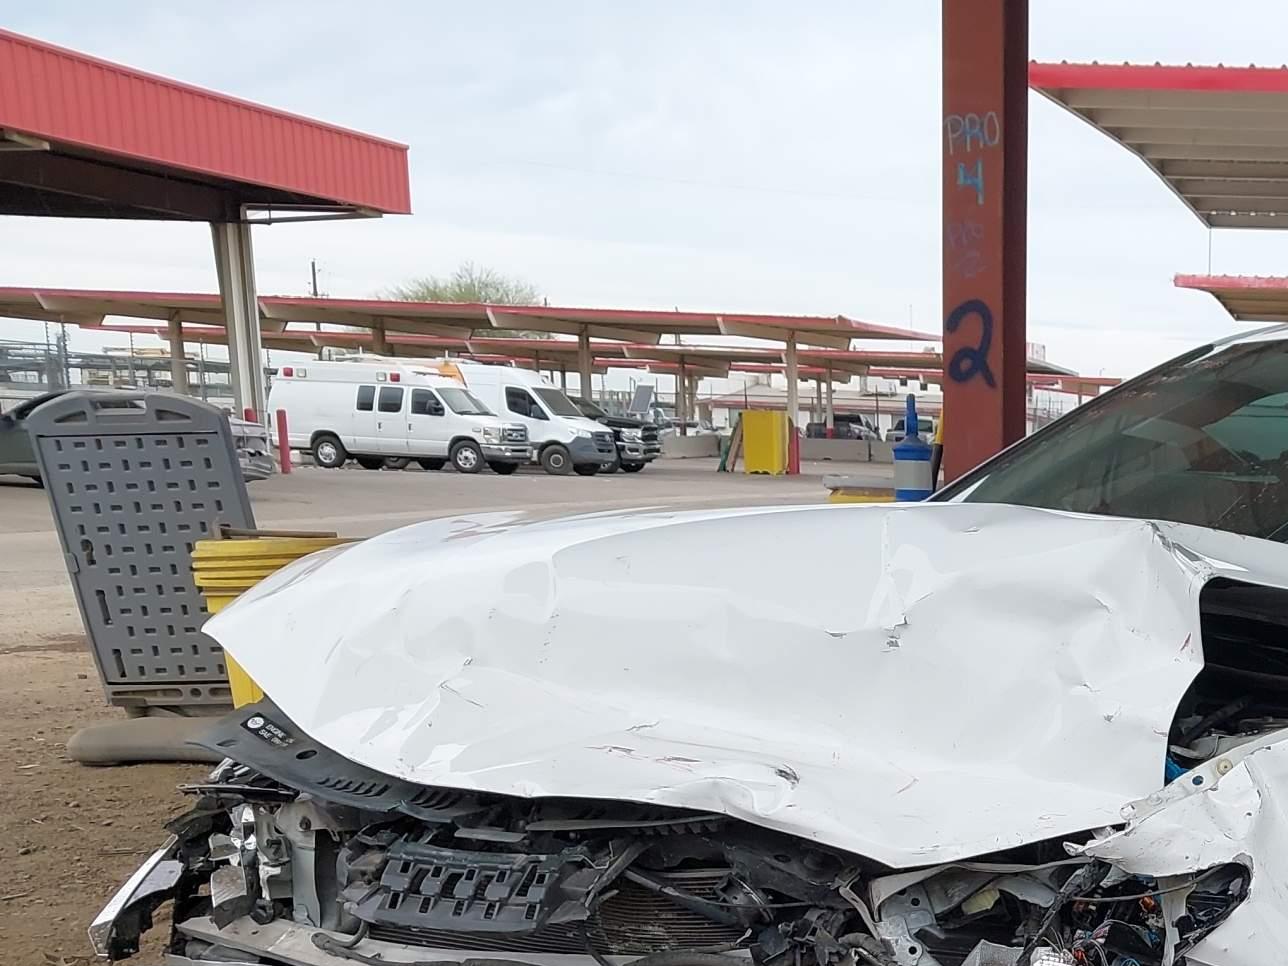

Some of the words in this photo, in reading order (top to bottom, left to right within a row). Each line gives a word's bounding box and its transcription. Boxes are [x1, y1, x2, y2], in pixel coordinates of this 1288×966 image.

[944, 111, 1000, 155] PRO
[957, 159, 985, 206] 4
[945, 298, 997, 389] 2
